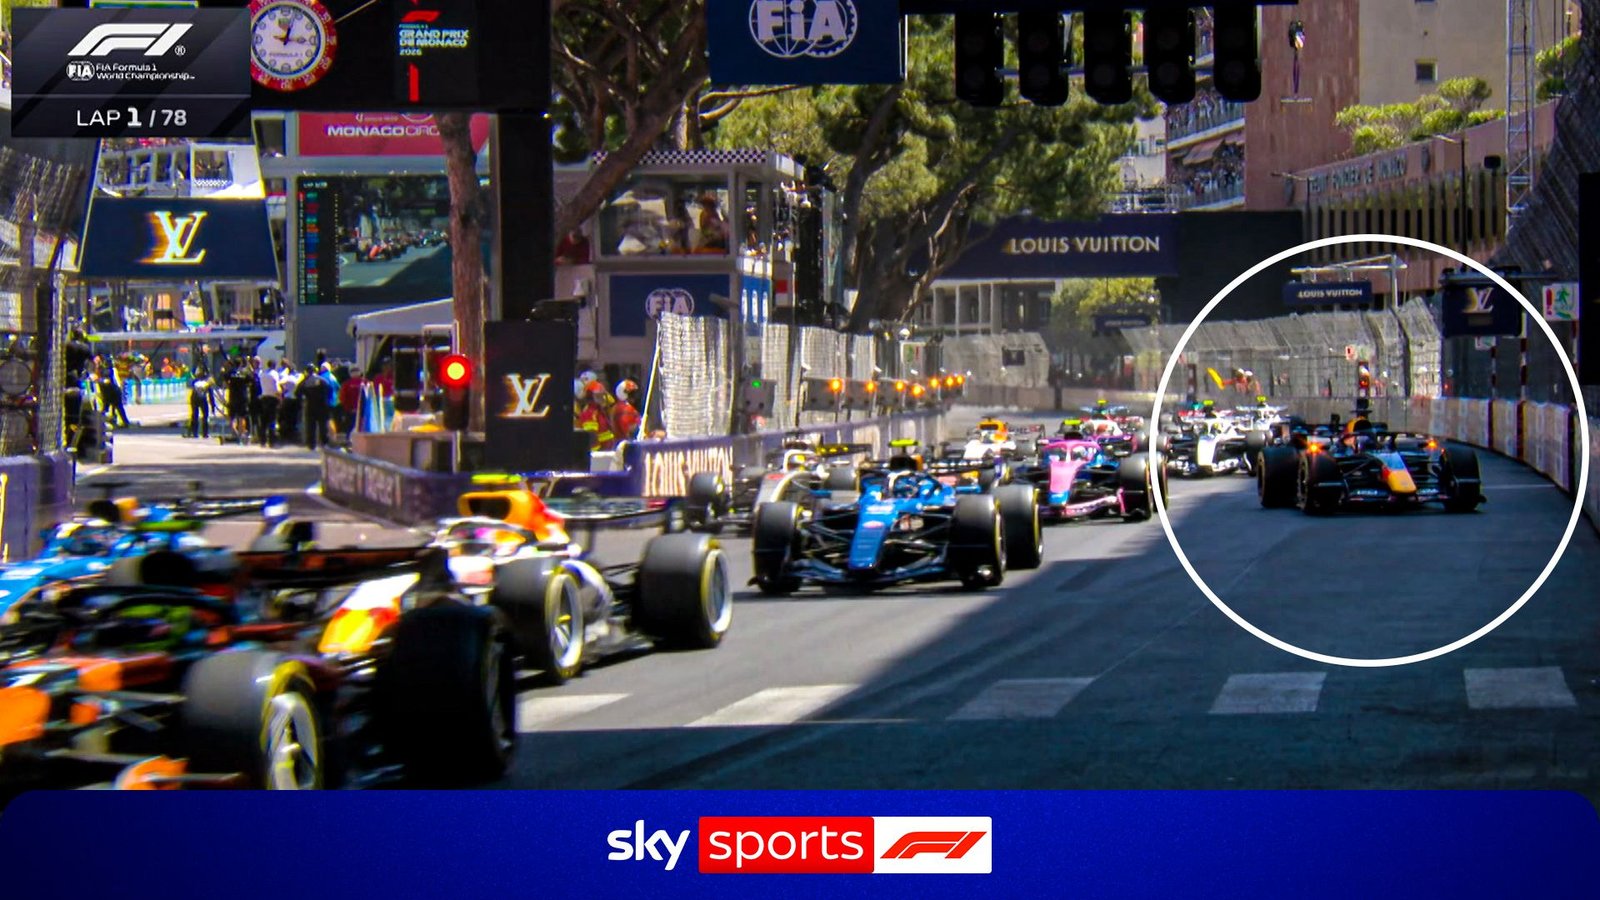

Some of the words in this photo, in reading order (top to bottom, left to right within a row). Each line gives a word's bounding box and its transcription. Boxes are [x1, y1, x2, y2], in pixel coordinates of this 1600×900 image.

[1010, 236, 1070, 254] LOUIS
[1074, 235, 1160, 253] VUITTON
[1298, 289, 1325, 299] LOUIS
[1325, 288, 1363, 298] VUITTON
